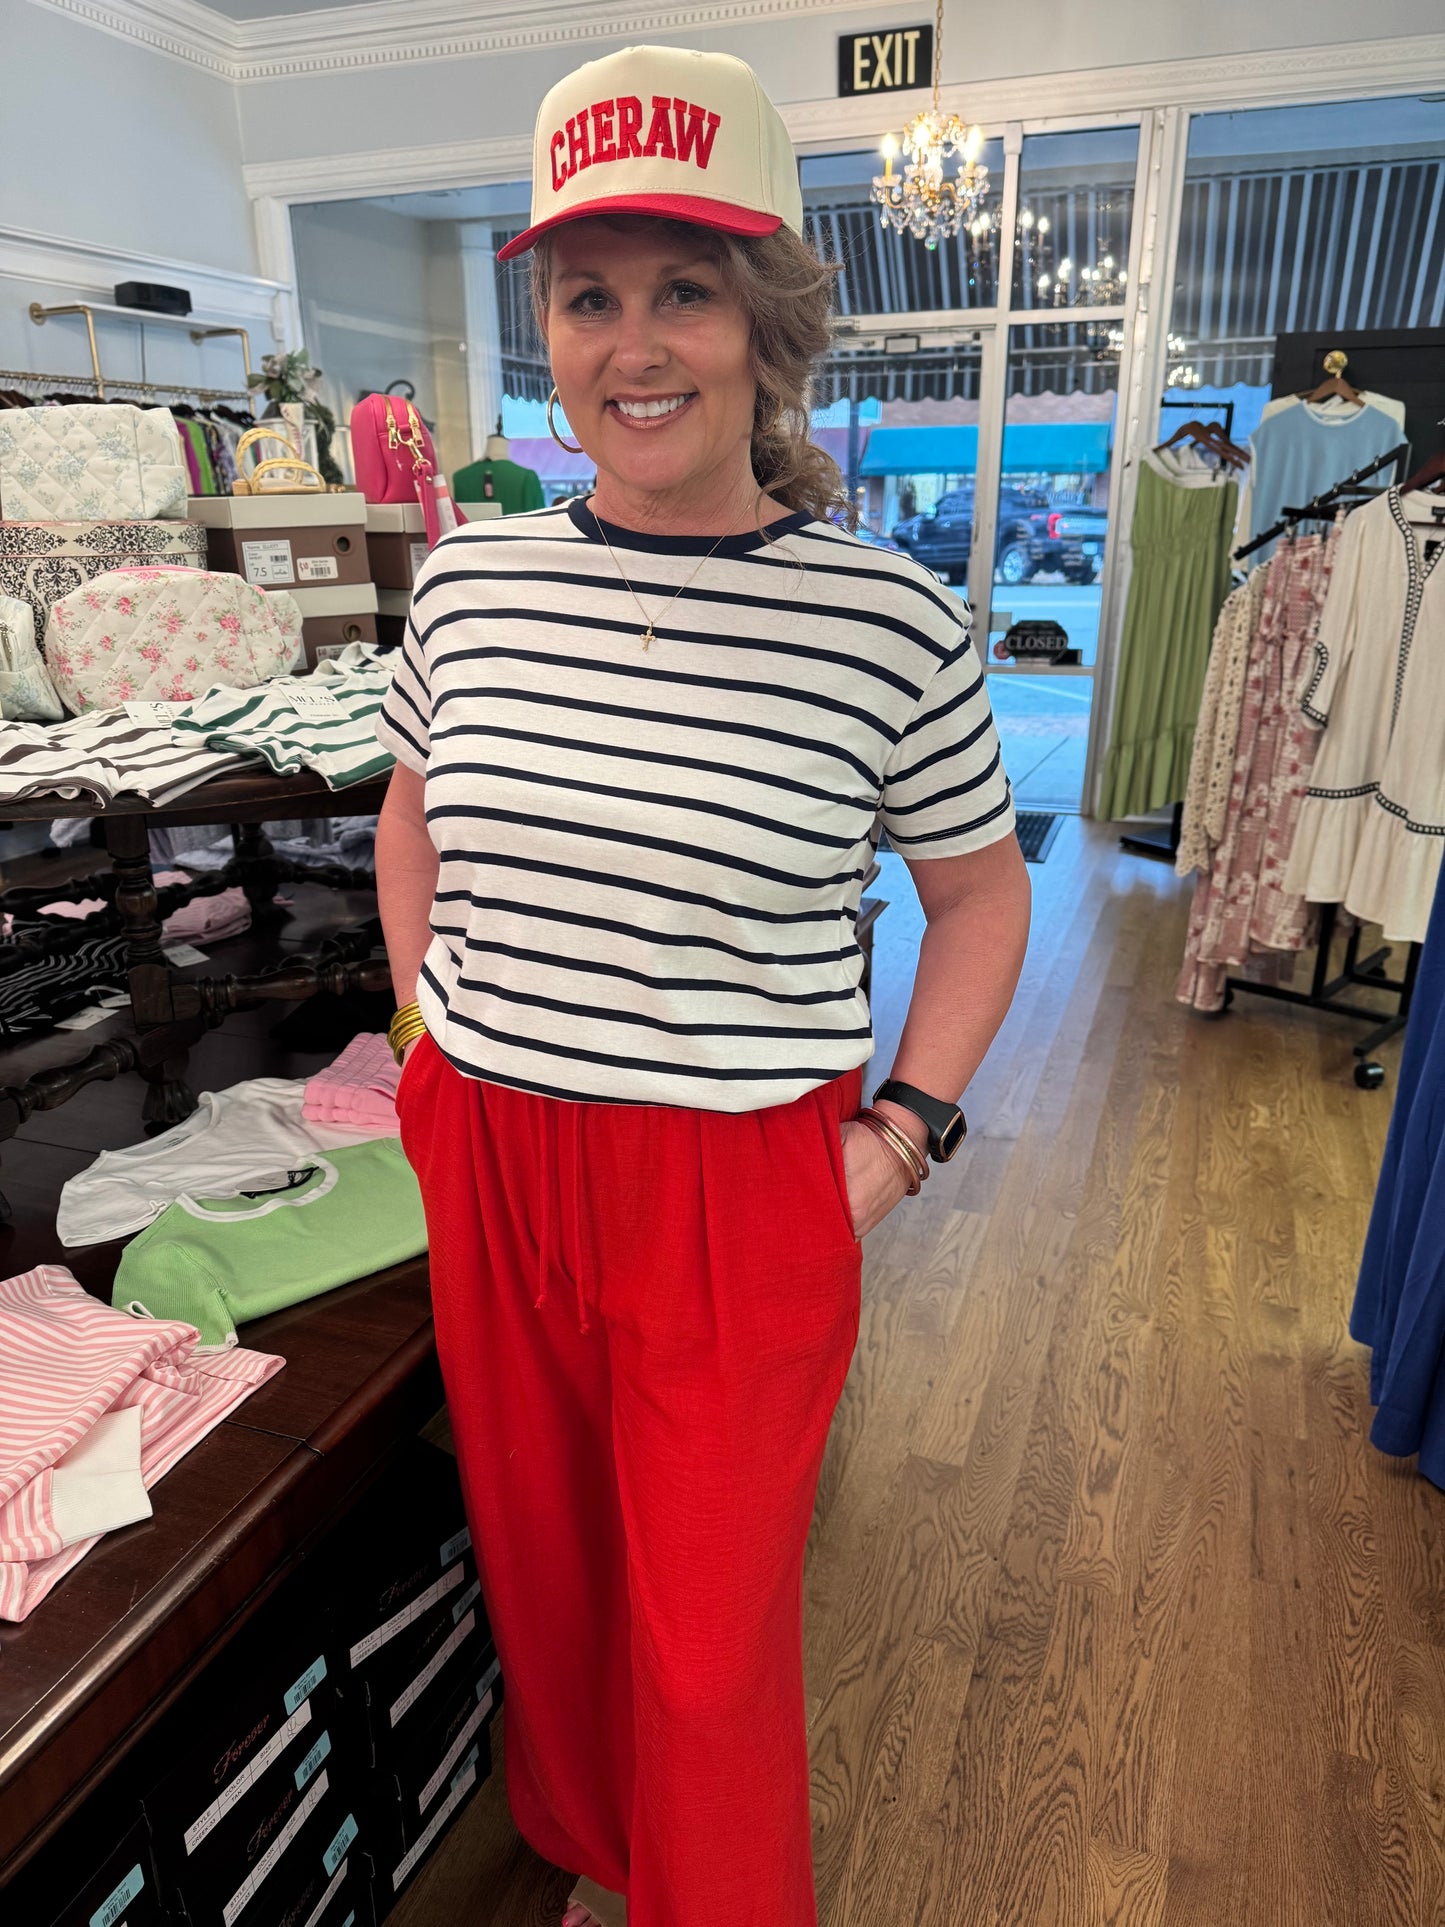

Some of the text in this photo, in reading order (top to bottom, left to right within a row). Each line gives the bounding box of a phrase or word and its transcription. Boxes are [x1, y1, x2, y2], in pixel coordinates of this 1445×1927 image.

[853, 30, 920, 91] EXIT
[550, 95, 721, 192] CHERAW
[1004, 634, 1067, 651] CLOSED
[213, 1714, 270, 1785] Forever
[192, 1744, 272, 1833] STYLE COLOR SIZE
[231, 1789, 243, 1802] TAN
